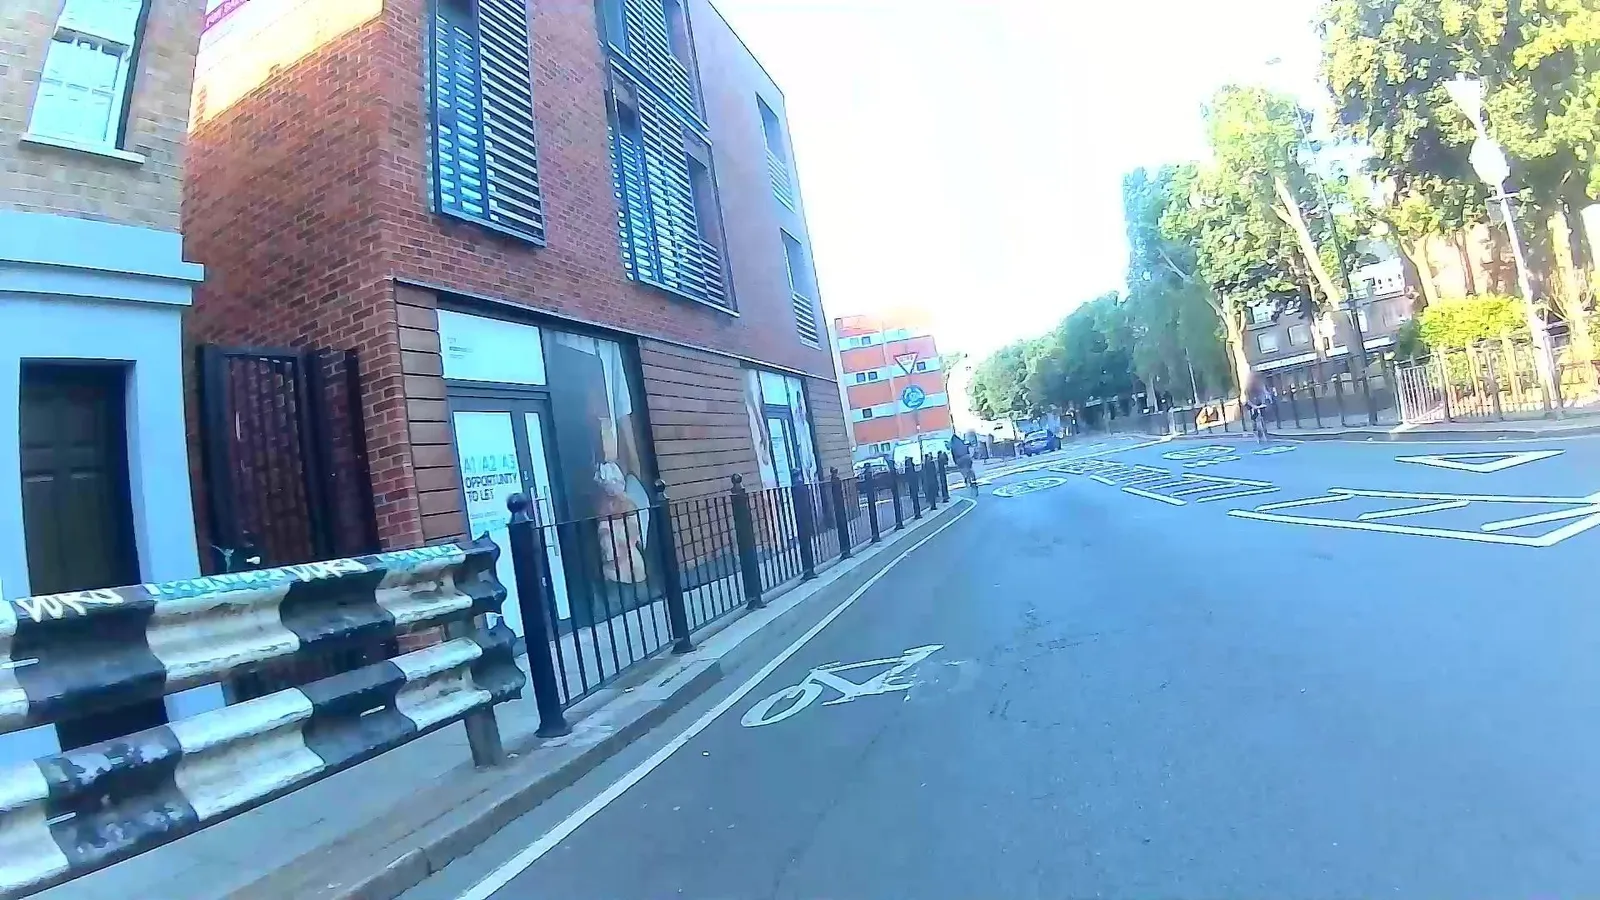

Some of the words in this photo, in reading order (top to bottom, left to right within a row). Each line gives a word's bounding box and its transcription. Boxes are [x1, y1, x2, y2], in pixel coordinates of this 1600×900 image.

[465, 472, 518, 489] OPPORTUNITY
[466, 490, 479, 502] TO
[480, 488, 494, 501] LET
